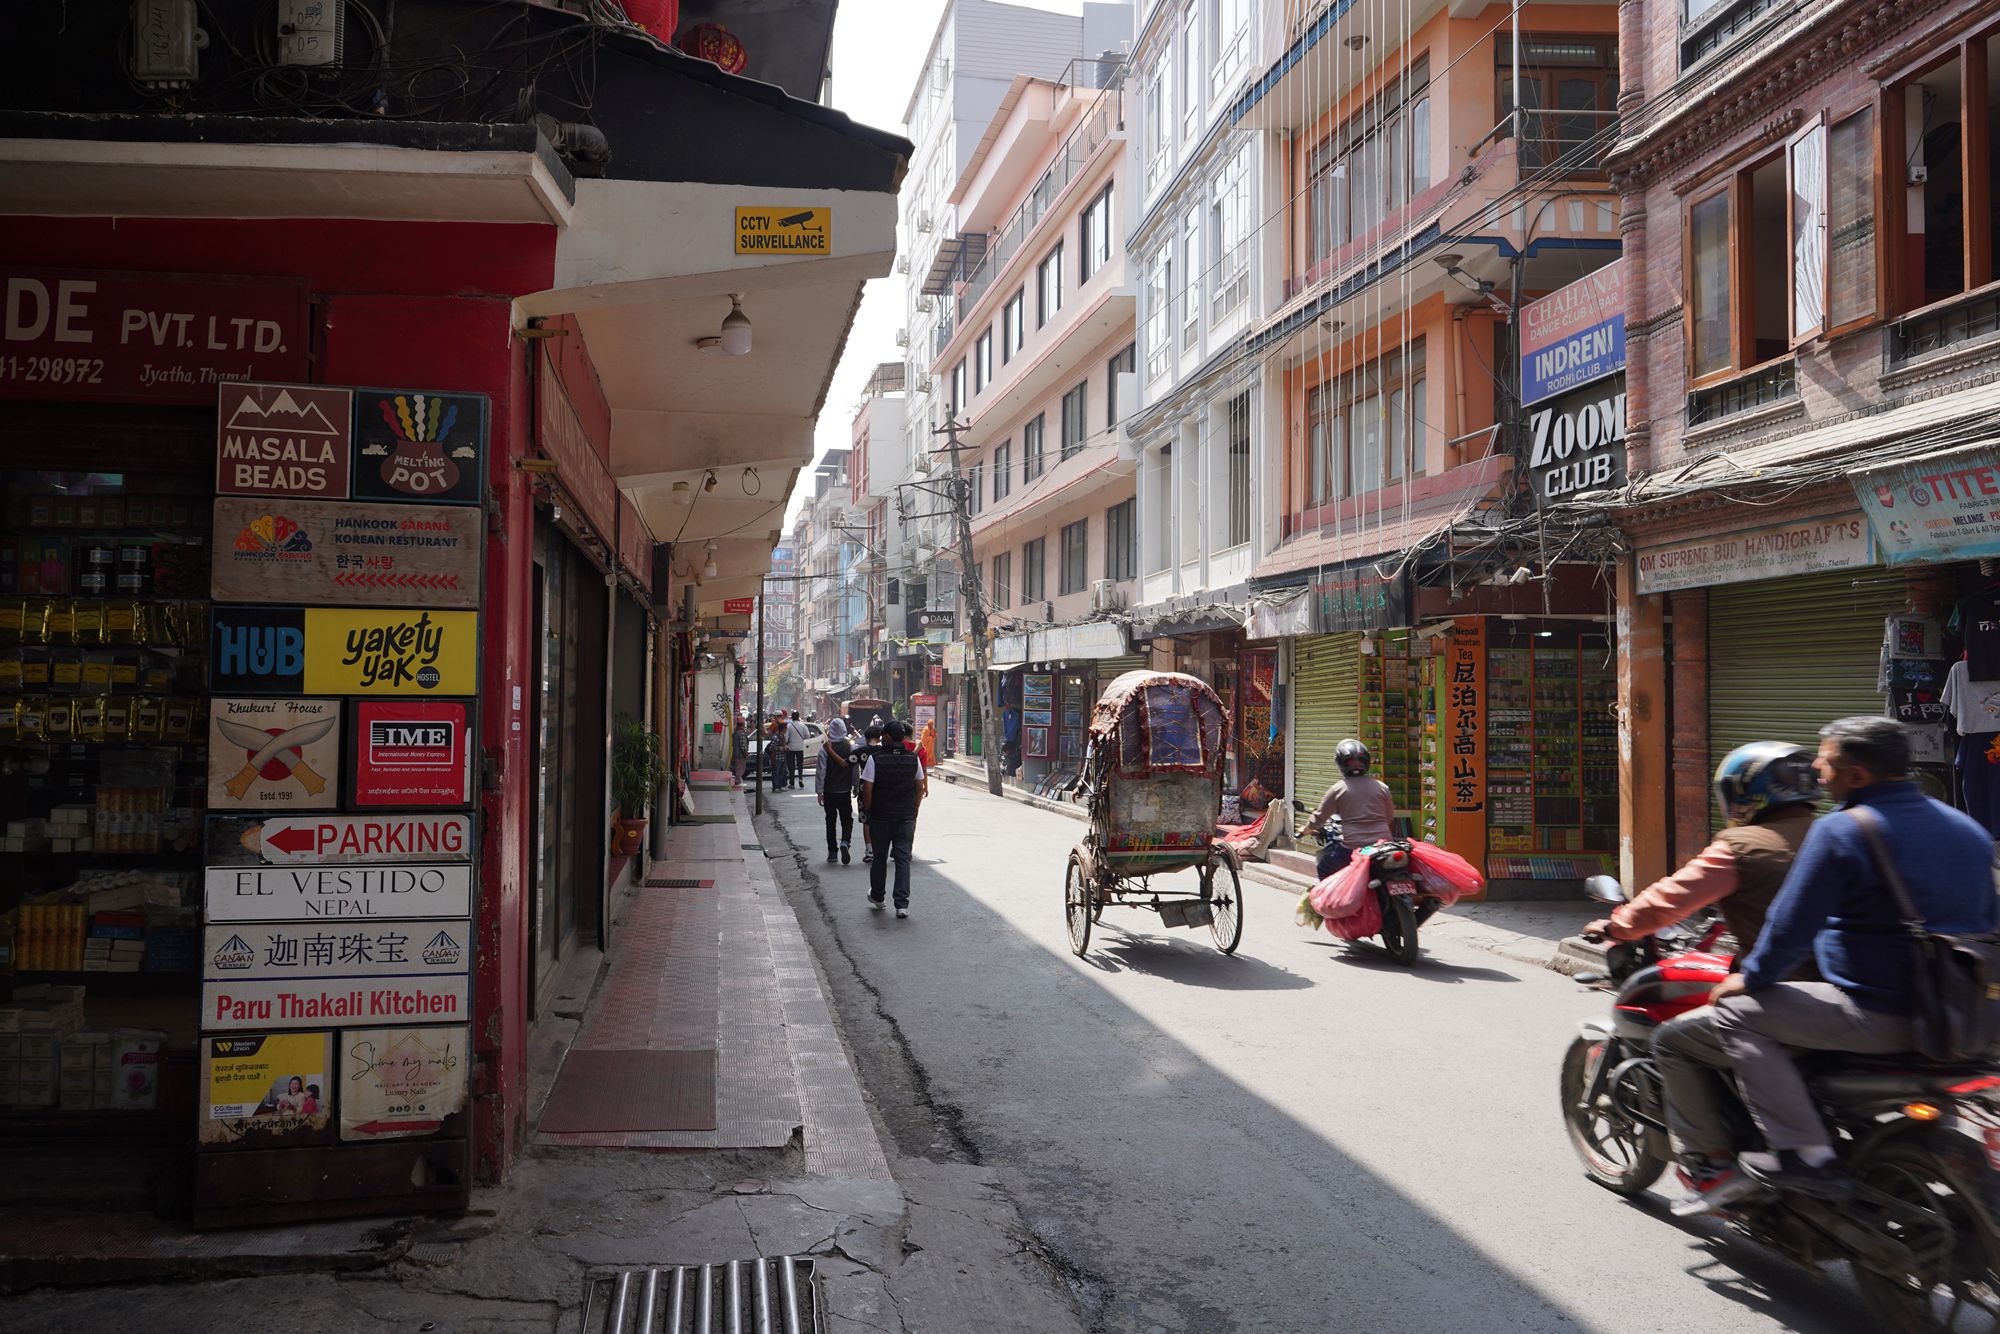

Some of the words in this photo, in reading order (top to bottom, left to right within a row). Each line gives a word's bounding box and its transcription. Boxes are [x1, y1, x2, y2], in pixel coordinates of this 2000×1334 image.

[741, 216, 770, 231] CCTV
[741, 234, 825, 249] SURVEILLANCE
[1527, 268, 1621, 328] CHAHANA
[1530, 315, 1560, 341] DANCE
[1562, 307, 1587, 326] CLUB
[1598, 290, 1619, 310] BAR
[120, 309, 195, 348] PVT.
[208, 315, 287, 354] LTD.
[1535, 324, 1614, 382] INDRENI
[1576, 361, 1601, 382] CLUB
[1530, 391, 1627, 468] ZOOM
[222, 435, 336, 464] MASALA
[234, 464, 327, 491] BEADS
[388, 467, 448, 492] POT
[1545, 453, 1612, 498] CLUB
[335, 518, 398, 530] HANKOOK
[400, 519, 451, 532] SARANG
[1953, 513, 1986, 526] MELANGE
[335, 534, 385, 545] KOREAN
[388, 535, 458, 547] RESTURANT
[1639, 555, 1656, 571] OM
[1659, 546, 1710, 569] SUPREME
[1744, 520, 1860, 556] HANDICRAFTS
[342, 612, 443, 665] yakety
[1454, 638, 1480, 646] Mountain
[1456, 627, 1479, 636] Nepali
[220, 625, 304, 676] HUB
[1458, 648, 1473, 660] Tea
[360, 654, 416, 687] yak
[416, 673, 440, 682] HOSTEL
[227, 702, 276, 715] Khukuri
[285, 702, 323, 714] House
[385, 728, 446, 746] IME
[317, 821, 462, 855] PARKING
[235, 871, 273, 896] EL
[291, 869, 446, 894] VESTIDO
[305, 899, 377, 916] NEPAL
[263, 932, 409, 967] 迦南珠宝
[216, 995, 271, 1020] Paru
[277, 991, 363, 1018] Thakali
[370, 989, 457, 1016] Kitchen
